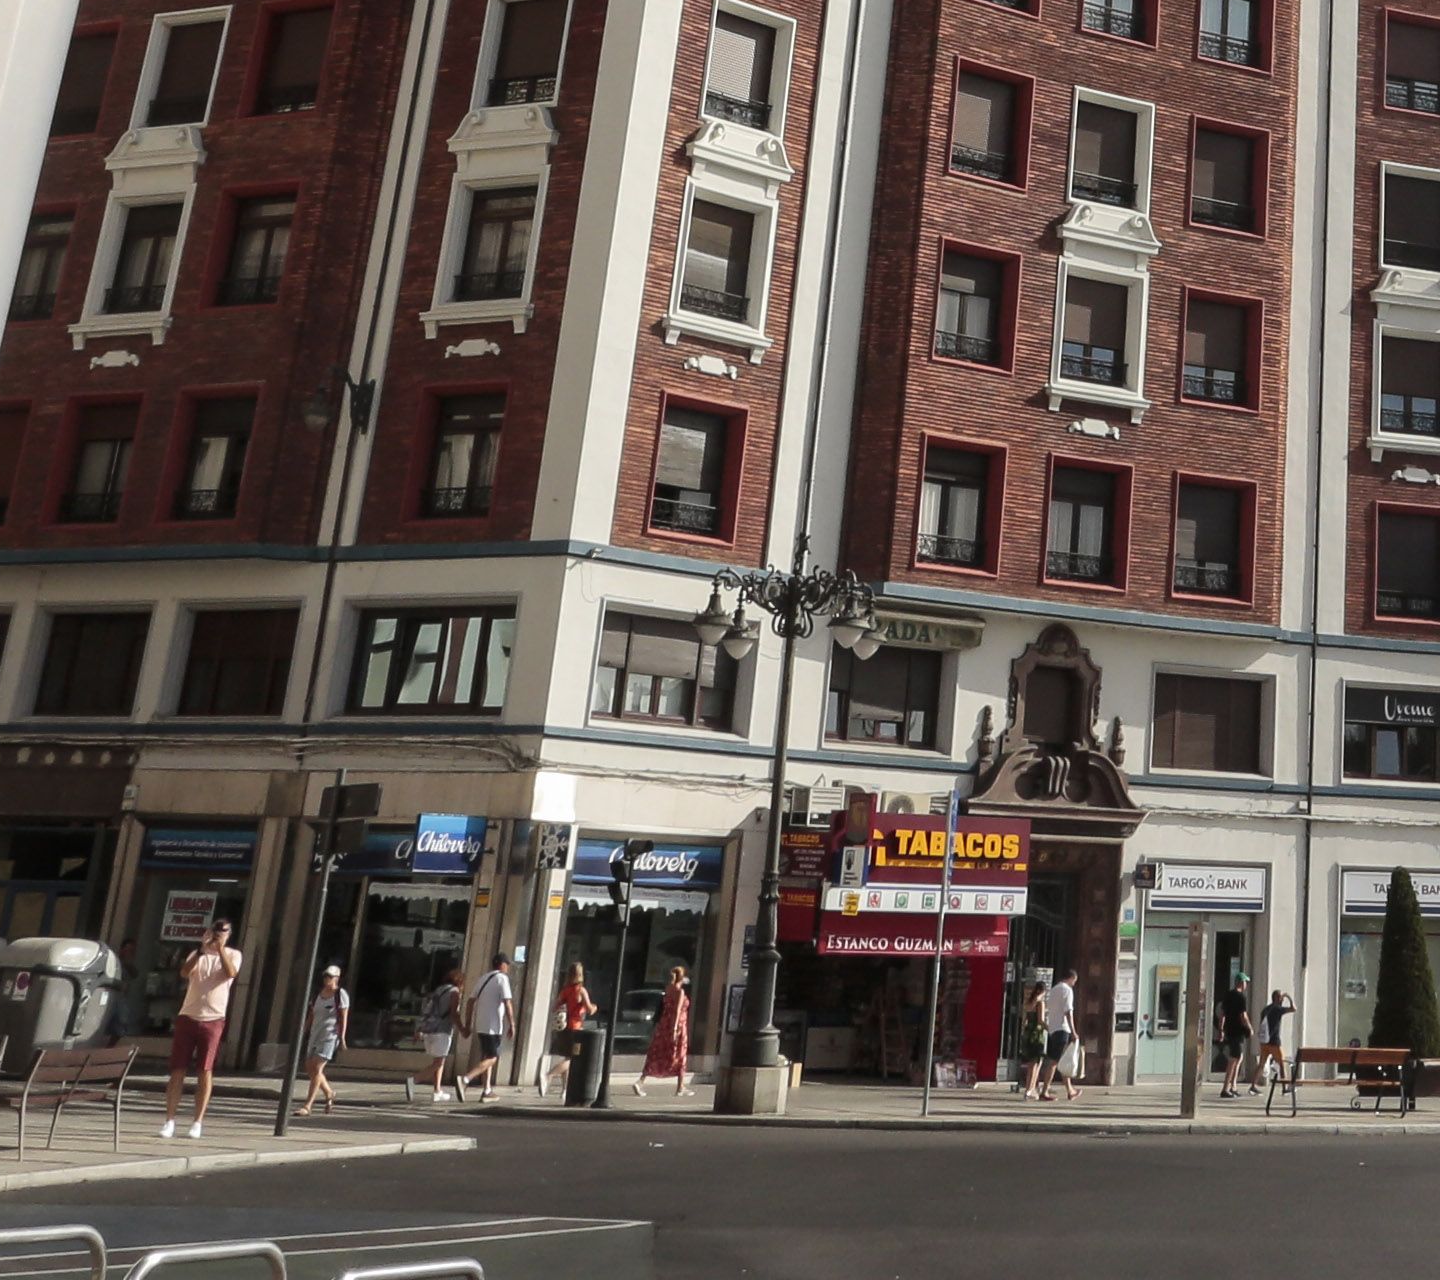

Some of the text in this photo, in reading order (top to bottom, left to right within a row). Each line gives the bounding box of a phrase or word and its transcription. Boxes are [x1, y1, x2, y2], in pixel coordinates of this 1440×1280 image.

[895, 828, 1020, 859] TABACOS
[1168, 876, 1248, 890] TARGO BANK
[827, 934, 889, 951] ESTANCO
